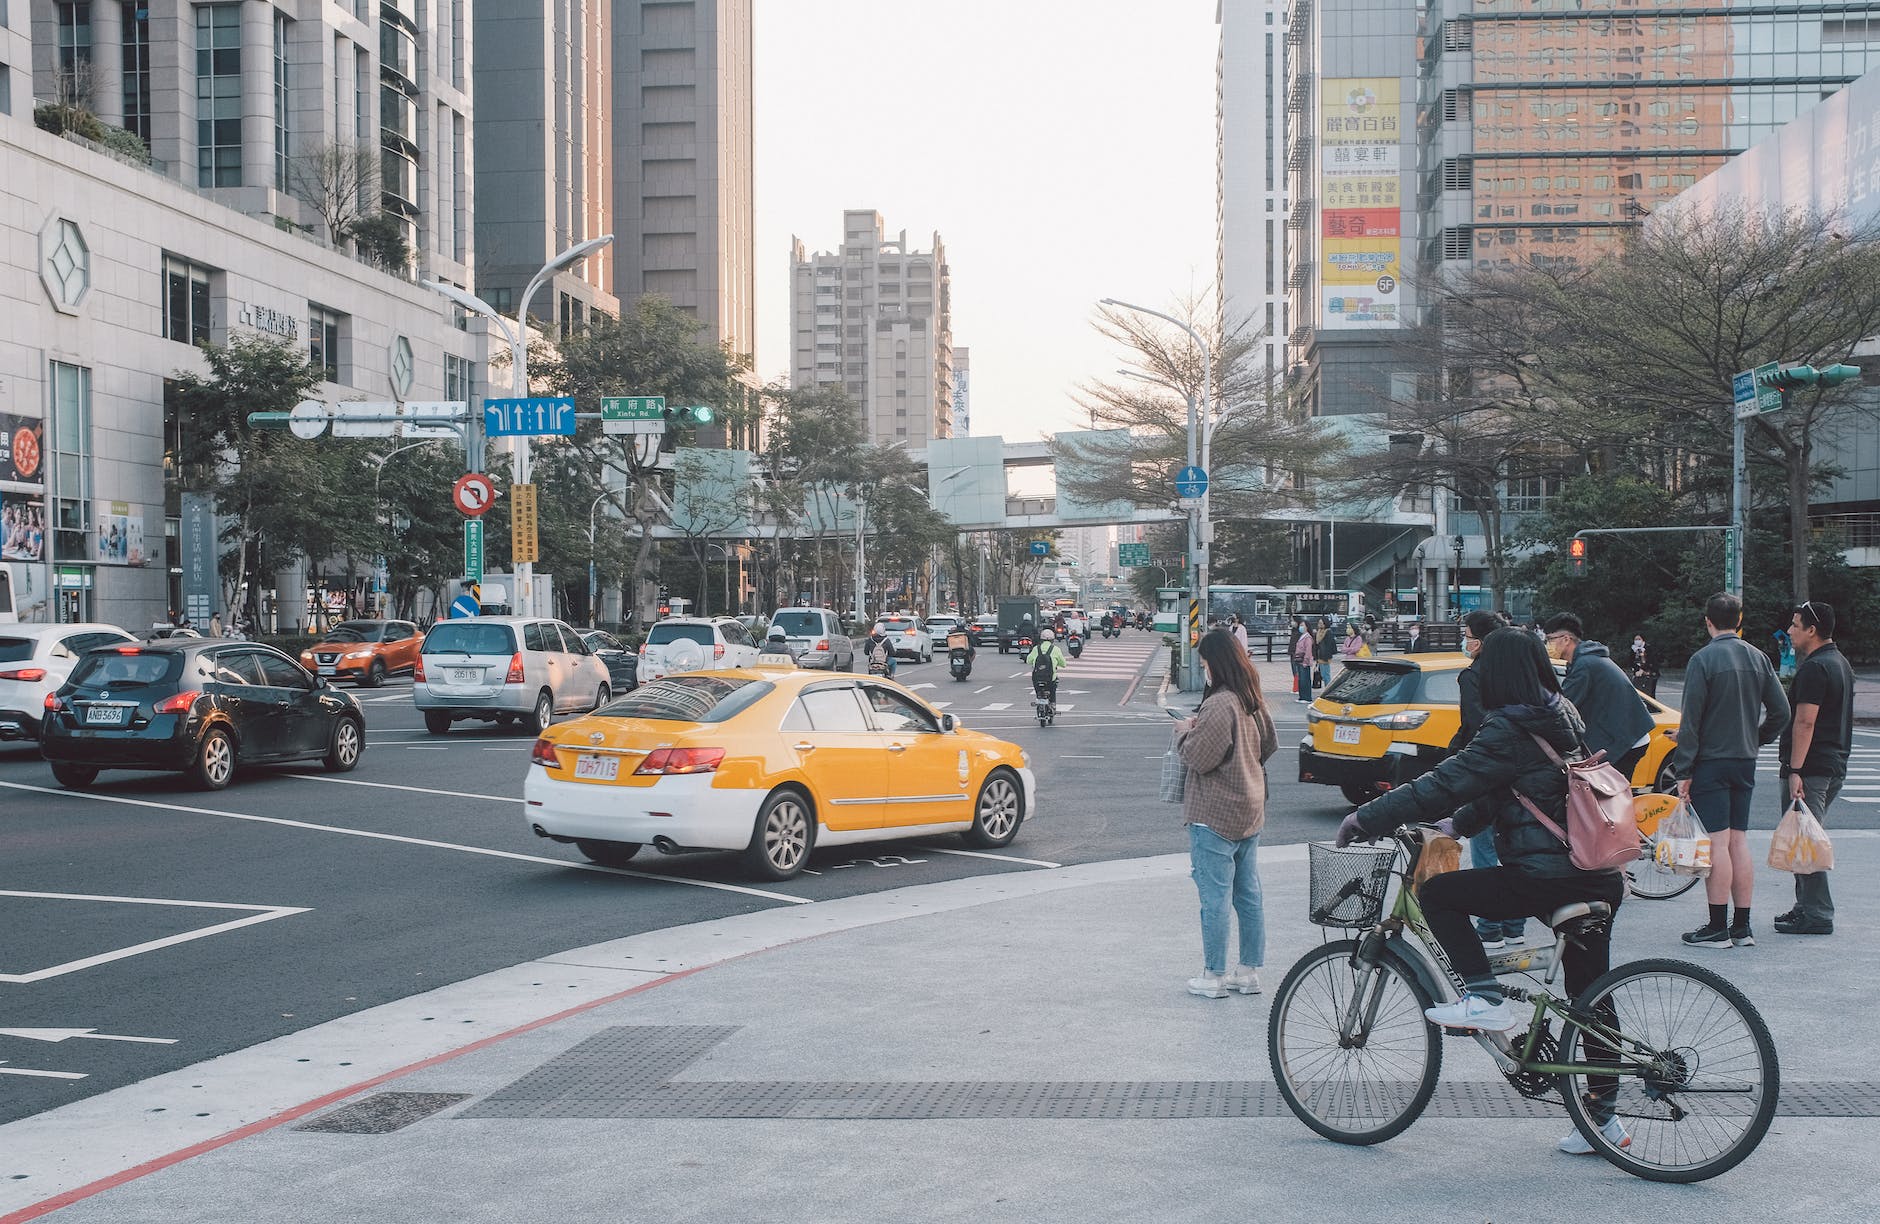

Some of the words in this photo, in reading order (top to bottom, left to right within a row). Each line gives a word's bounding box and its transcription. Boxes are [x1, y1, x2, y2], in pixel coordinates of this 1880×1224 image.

[1327, 212, 1366, 235] 藝奇
[1379, 279, 1393, 291] 5F
[609, 399, 656, 410] 新府路
[761, 655, 785, 664] TAXI
